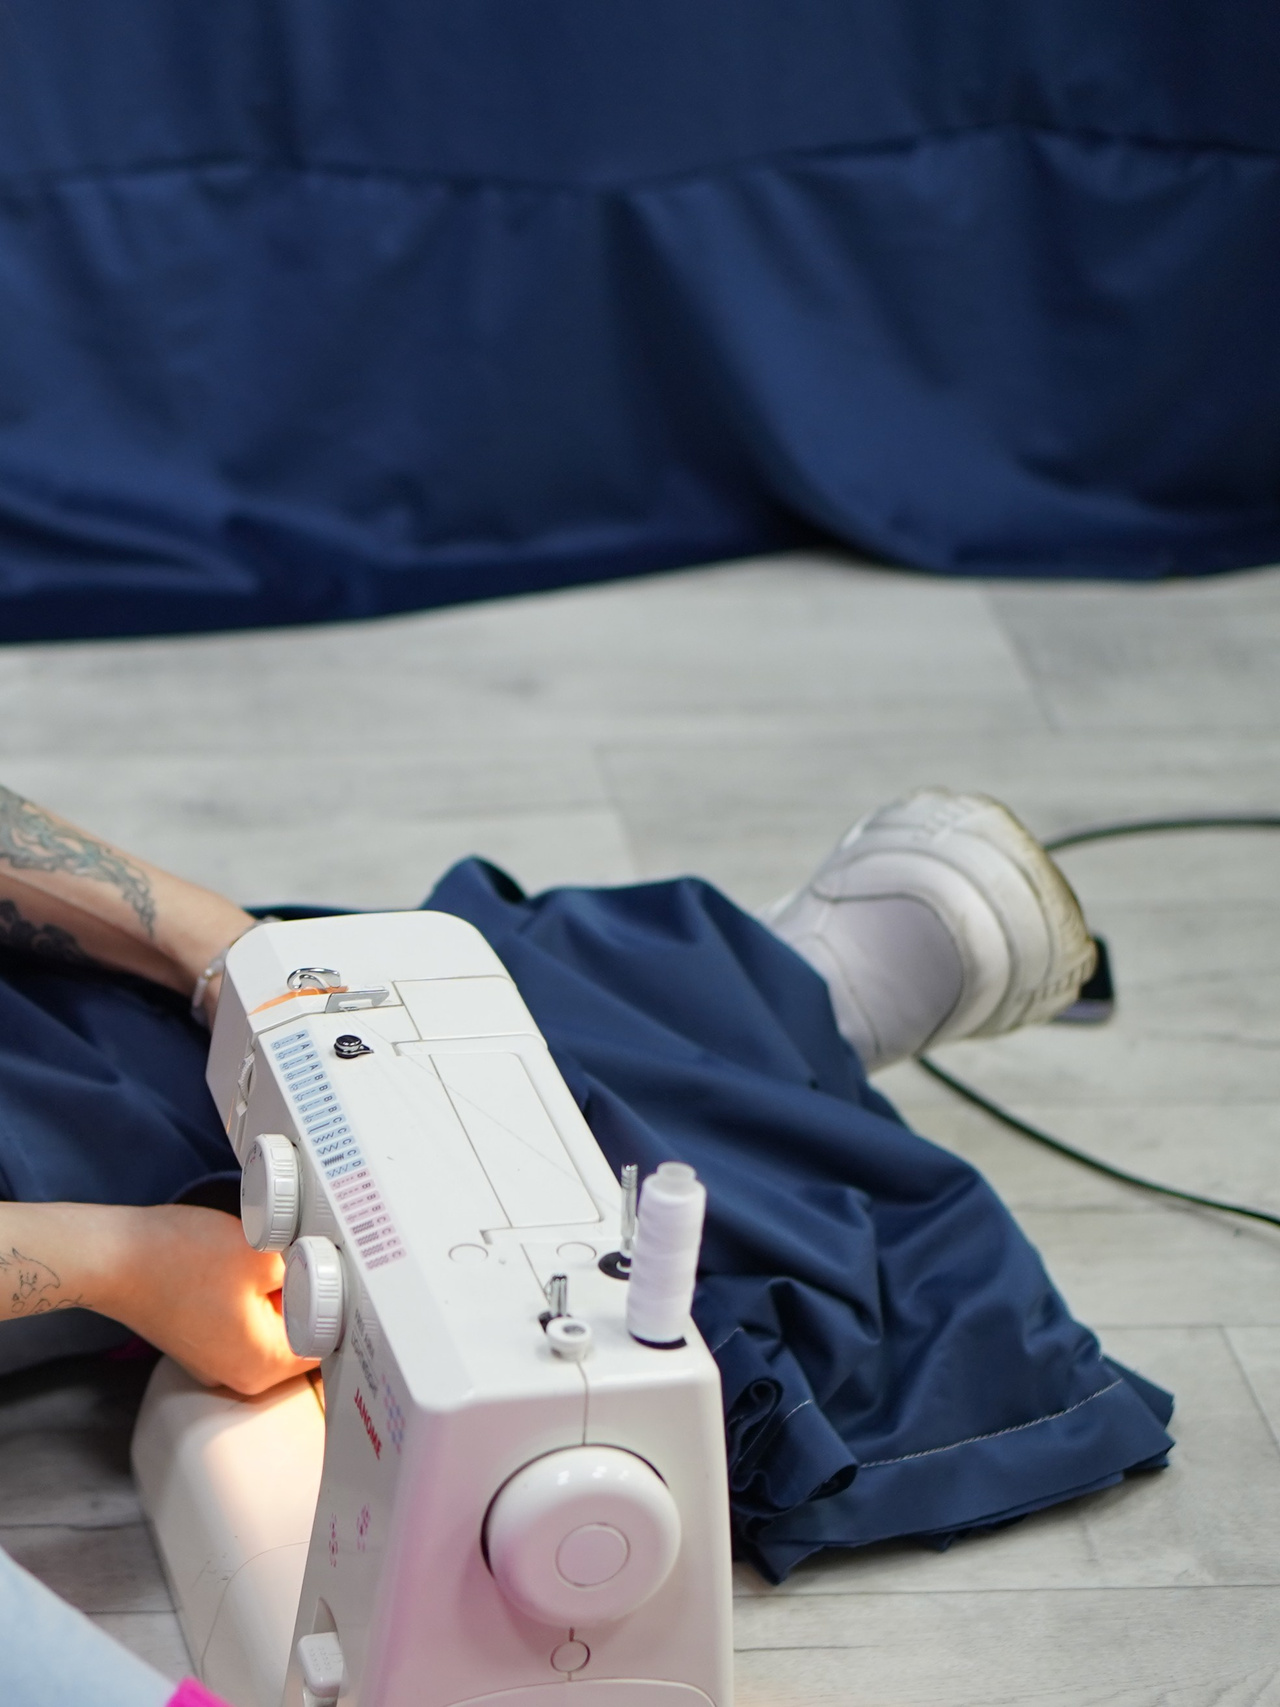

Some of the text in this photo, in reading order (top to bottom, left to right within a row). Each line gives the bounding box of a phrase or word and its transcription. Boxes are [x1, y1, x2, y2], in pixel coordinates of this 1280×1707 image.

[328, 1105, 337, 1113] B
[332, 1116, 342, 1124] C
[366, 1193, 376, 1201] B
[371, 1204, 381, 1212] B
[354, 1386, 382, 1461] JANOME
